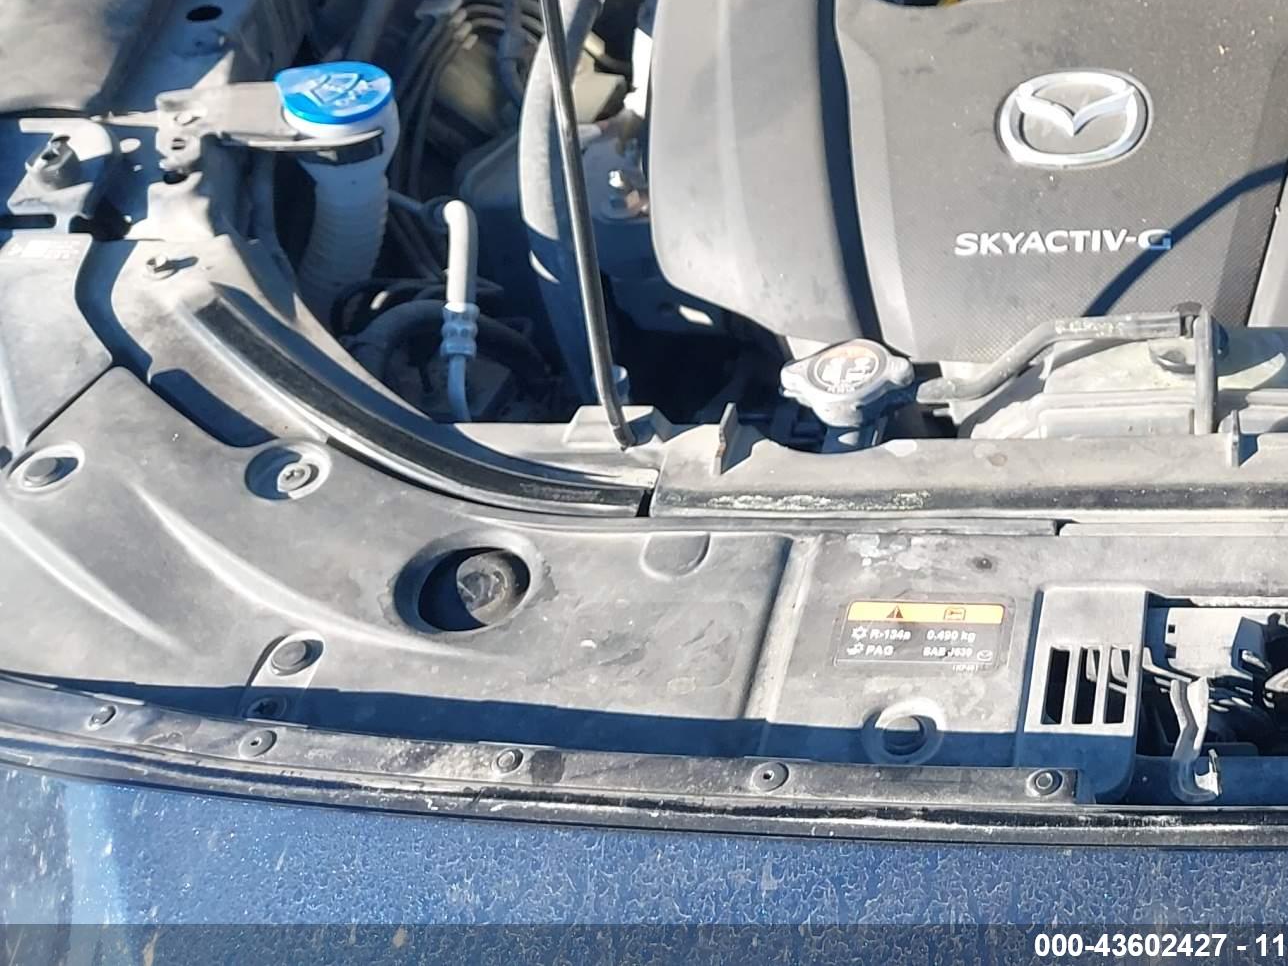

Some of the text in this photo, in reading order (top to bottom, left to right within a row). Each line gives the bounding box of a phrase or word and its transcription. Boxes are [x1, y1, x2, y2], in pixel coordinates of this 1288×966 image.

[954, 229, 1172, 256] SKYACTIV-G
[869, 629, 911, 641] R-134a
[961, 630, 976, 643] kg
[865, 645, 894, 656] PAG
